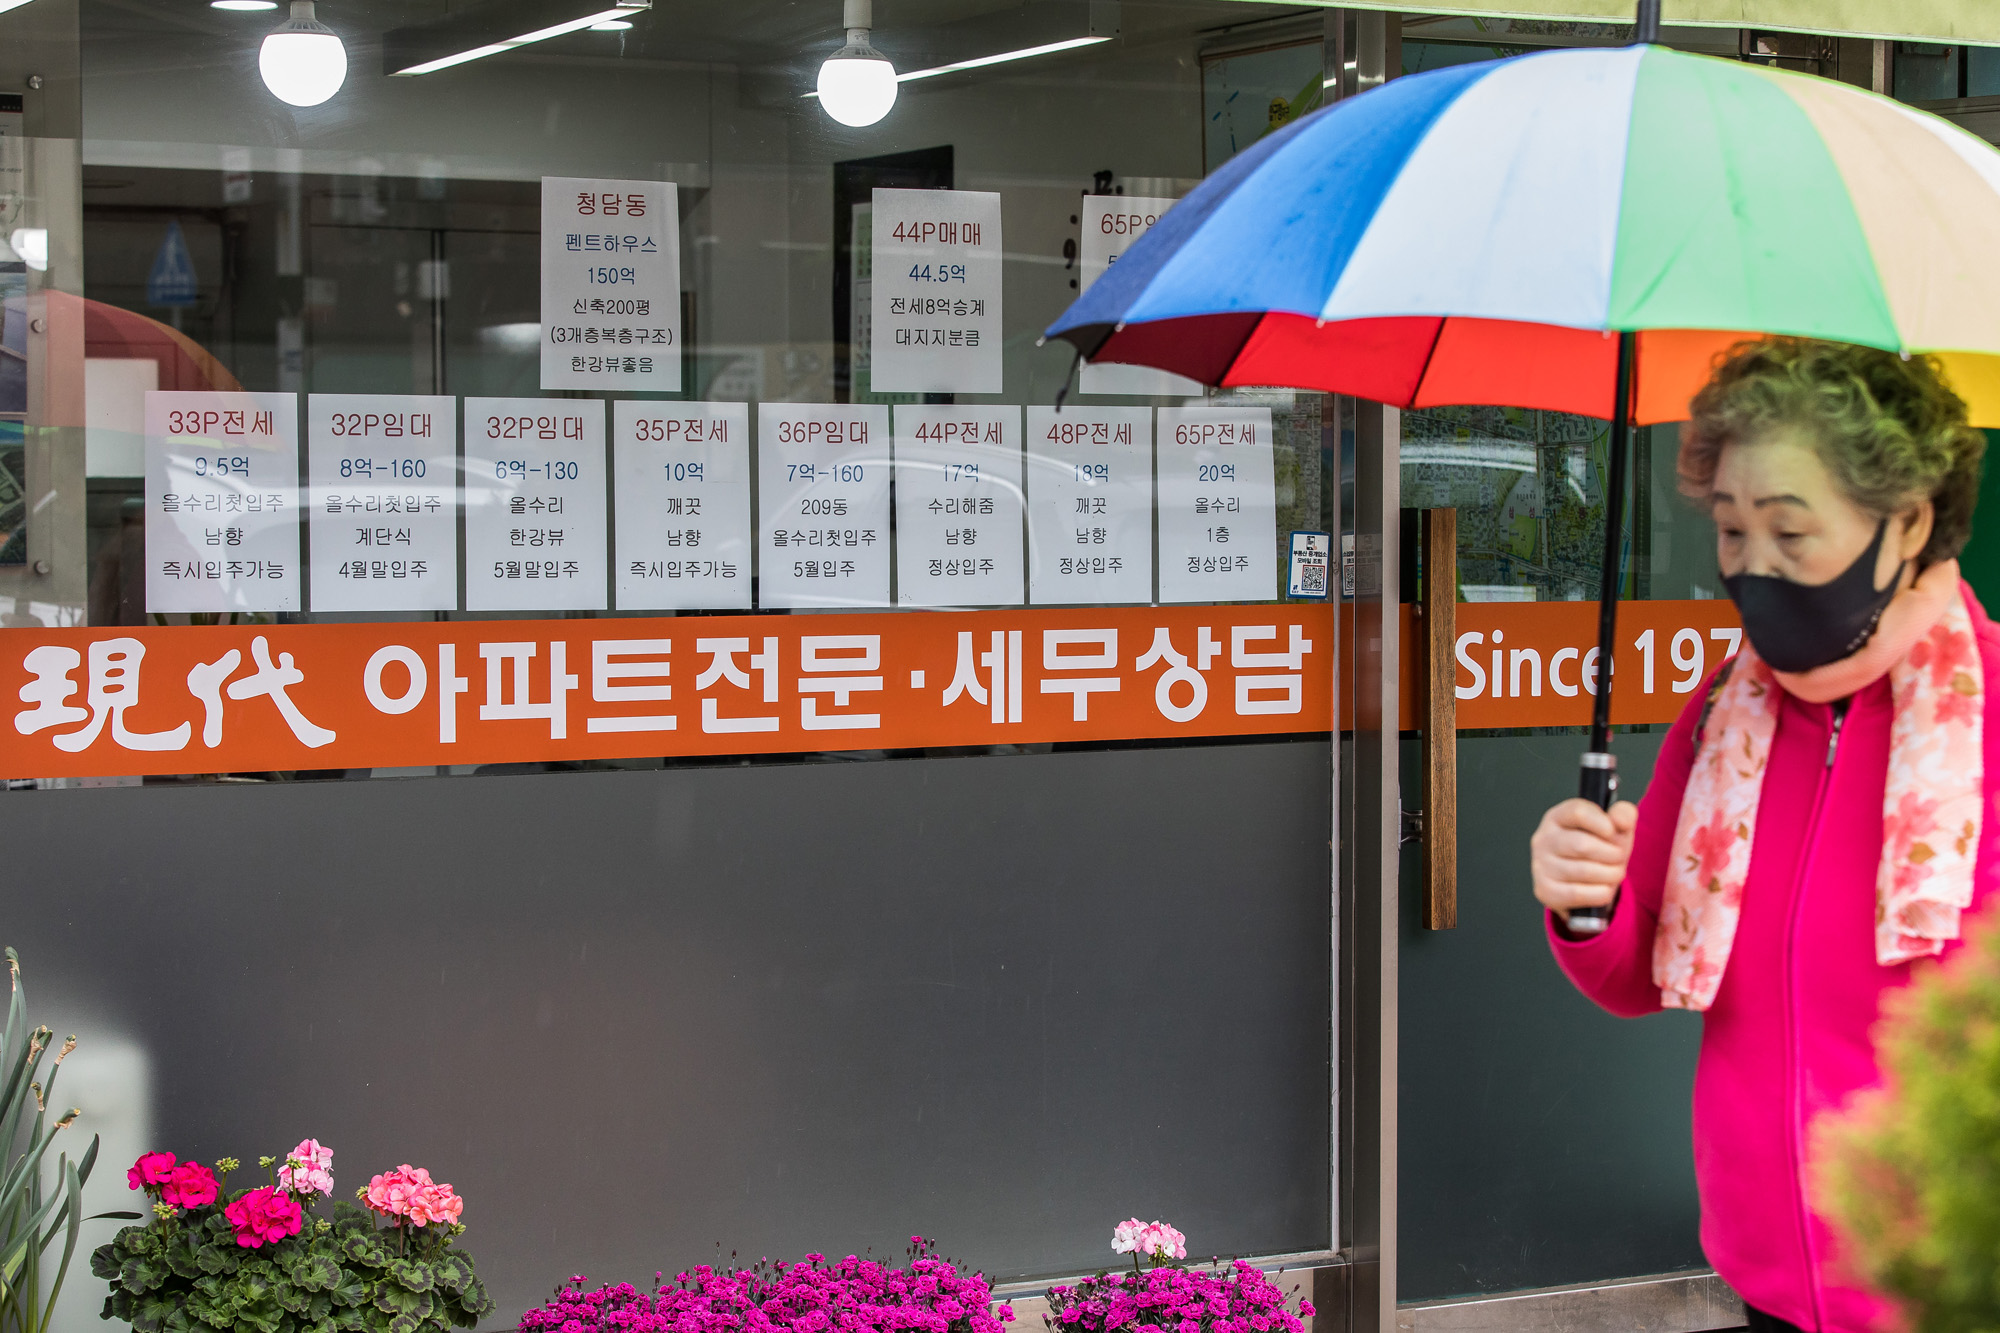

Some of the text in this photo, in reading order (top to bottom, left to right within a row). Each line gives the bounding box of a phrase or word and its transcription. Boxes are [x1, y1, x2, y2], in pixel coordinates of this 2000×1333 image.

[577, 193, 646, 216] 청담동
[892, 221, 980, 245] 44P매매
[565, 234, 657, 253] 펜트하우스
[588, 267, 634, 285] 150억
[909, 264, 965, 284] 44.5억
[573, 299, 649, 316] 신축200평
[890, 298, 984, 316] 전세8억승계
[551, 326, 672, 345] (3개층복층구조)
[896, 329, 980, 346] 대지지분큼
[571, 356, 653, 373] 한강뷰좋음
[169, 411, 272, 435] 33P전세
[332, 413, 431, 437] 32P임대
[487, 416, 583, 440] 32P임대
[636, 419, 727, 442] 35P전세
[779, 421, 868, 444] 36P임대
[915, 422, 1002, 445] 44P전세
[1047, 423, 1131, 445] 48P전세
[1176, 424, 1255, 445] 65P전세
[195, 457, 249, 477] 9.5억
[664, 463, 703, 482] 10억
[943, 464, 978, 482] 17억
[1074, 464, 1108, 482] 18억
[1199, 464, 1234, 482] 20억
[162, 494, 284, 513] 올수리첫입주
[326, 495, 441, 513] 올수리첫입주
[509, 497, 562, 514] 올수리
[667, 498, 701, 516] 깨끗
[801, 499, 848, 516] 209동
[928, 498, 994, 515] 수리해줌
[1076, 498, 1106, 515] 깨끗
[1195, 497, 1239, 513] 올수리
[205, 528, 243, 546] 남향
[356, 528, 411, 546] 계단식
[510, 529, 564, 546] 한강뷰
[668, 529, 701, 547] 남향
[773, 530, 876, 547] 올수리첫입주
[946, 528, 977, 545] 남향
[1077, 528, 1106, 544] 남향
[1207, 527, 1229, 543] 1층
[162, 561, 284, 579] 즉시입주가능
[339, 561, 427, 579] 4월말입주
[494, 561, 579, 578] 5월말입주
[630, 561, 737, 578] 즉시입주가능
[794, 561, 855, 577] 5월입주
[929, 559, 994, 576] 정상입주
[1060, 557, 1122, 574] 정상입주
[1187, 556, 1248, 573] 정상입주
[1455, 629, 1614, 700] Since
[14, 636, 336, 752] 現代
